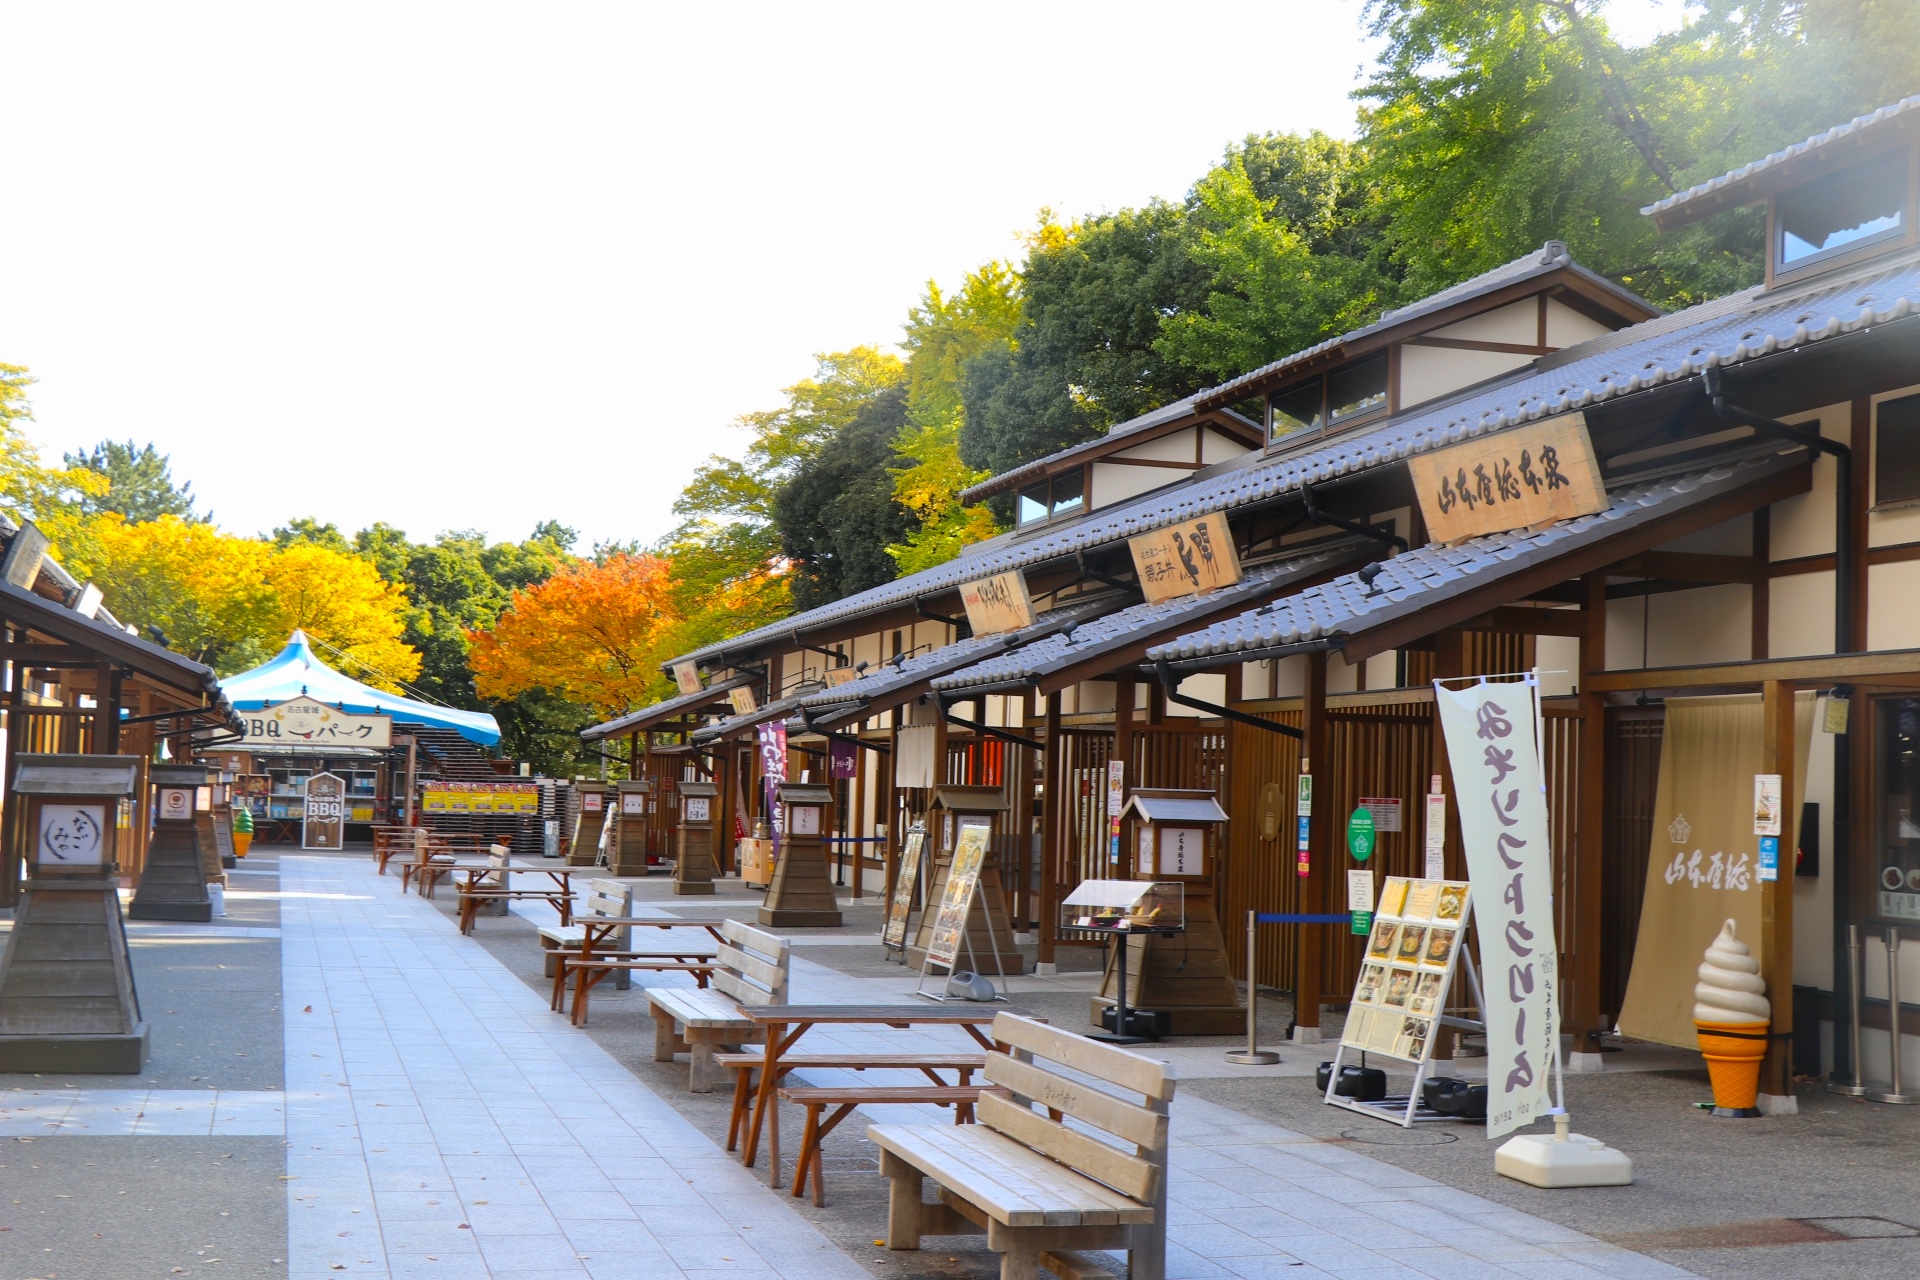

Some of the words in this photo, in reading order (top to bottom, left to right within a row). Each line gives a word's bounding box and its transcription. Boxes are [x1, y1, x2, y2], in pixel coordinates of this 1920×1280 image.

[1437, 444, 1570, 514] 山本屋総本家
[287, 705, 320, 714] 名古屋城
[245, 719, 282, 738] BQ
[317, 723, 373, 738] パーク
[308, 802, 341, 816] BBQ
[1664, 848, 1763, 892] 山本屋総
